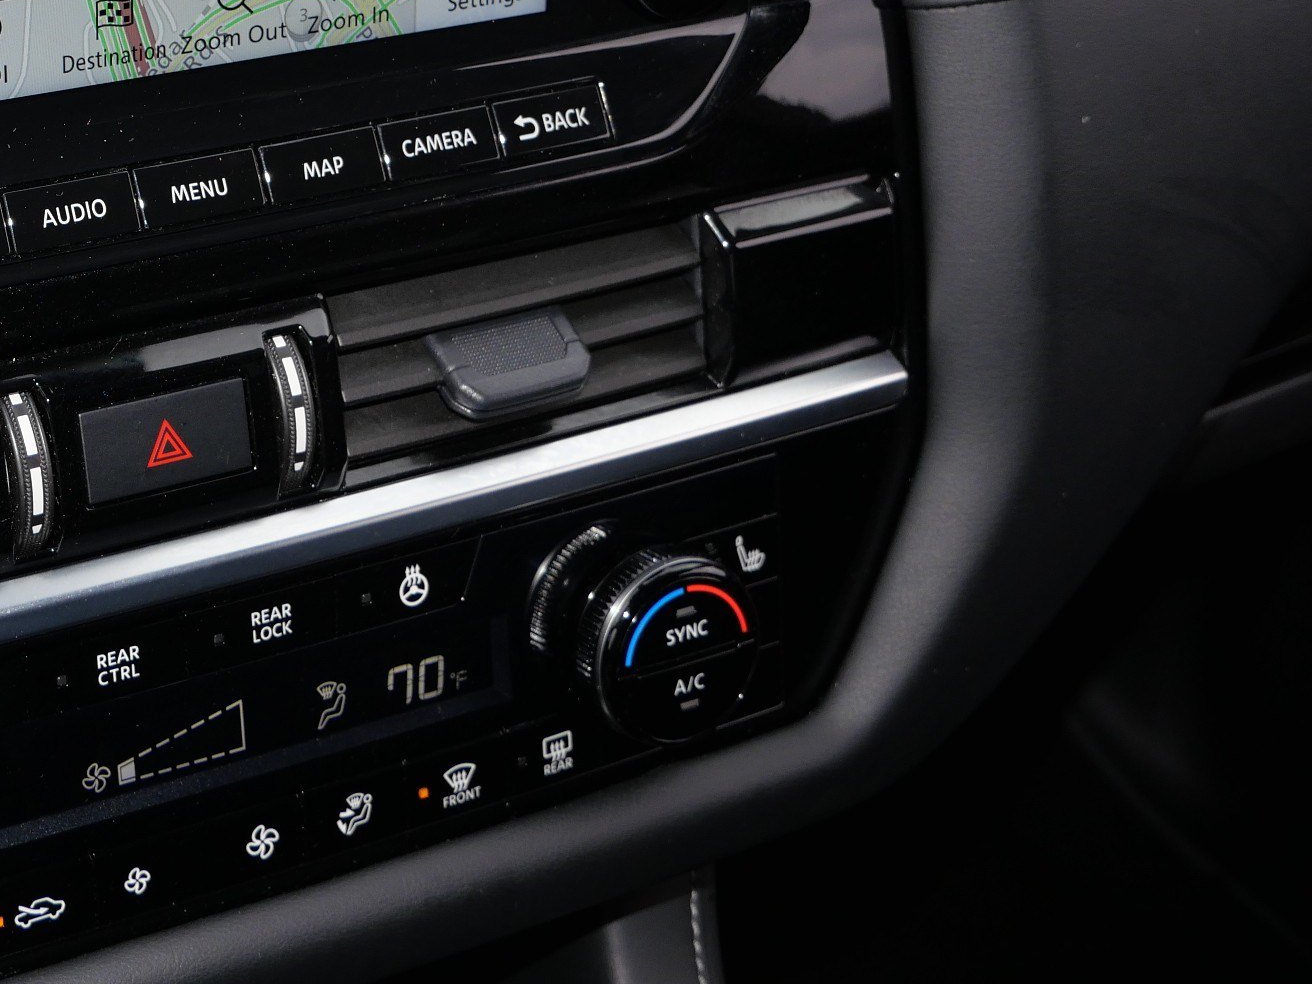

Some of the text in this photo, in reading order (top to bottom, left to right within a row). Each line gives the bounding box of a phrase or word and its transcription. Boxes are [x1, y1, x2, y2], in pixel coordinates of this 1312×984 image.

[307, 12, 365, 35] Zoom
[372, 6, 390, 24] In
[181, 21, 288, 55] Zoom Out
[62, 42, 166, 74] Destination
[542, 106, 590, 133] BACK
[401, 127, 478, 159] CAMERA
[302, 155, 344, 181] MAP
[170, 177, 229, 204] MENU
[41, 198, 108, 229] AUDIO
[250, 603, 293, 629] REAR
[251, 620, 293, 644] LOCK
[665, 618, 710, 647] SYNC
[96, 645, 141, 671] REAR
[97, 663, 141, 687] CTRL
[674, 672, 706, 697] A/C
[543, 756, 574, 777] REAR
[442, 785, 483, 809] FRONT
